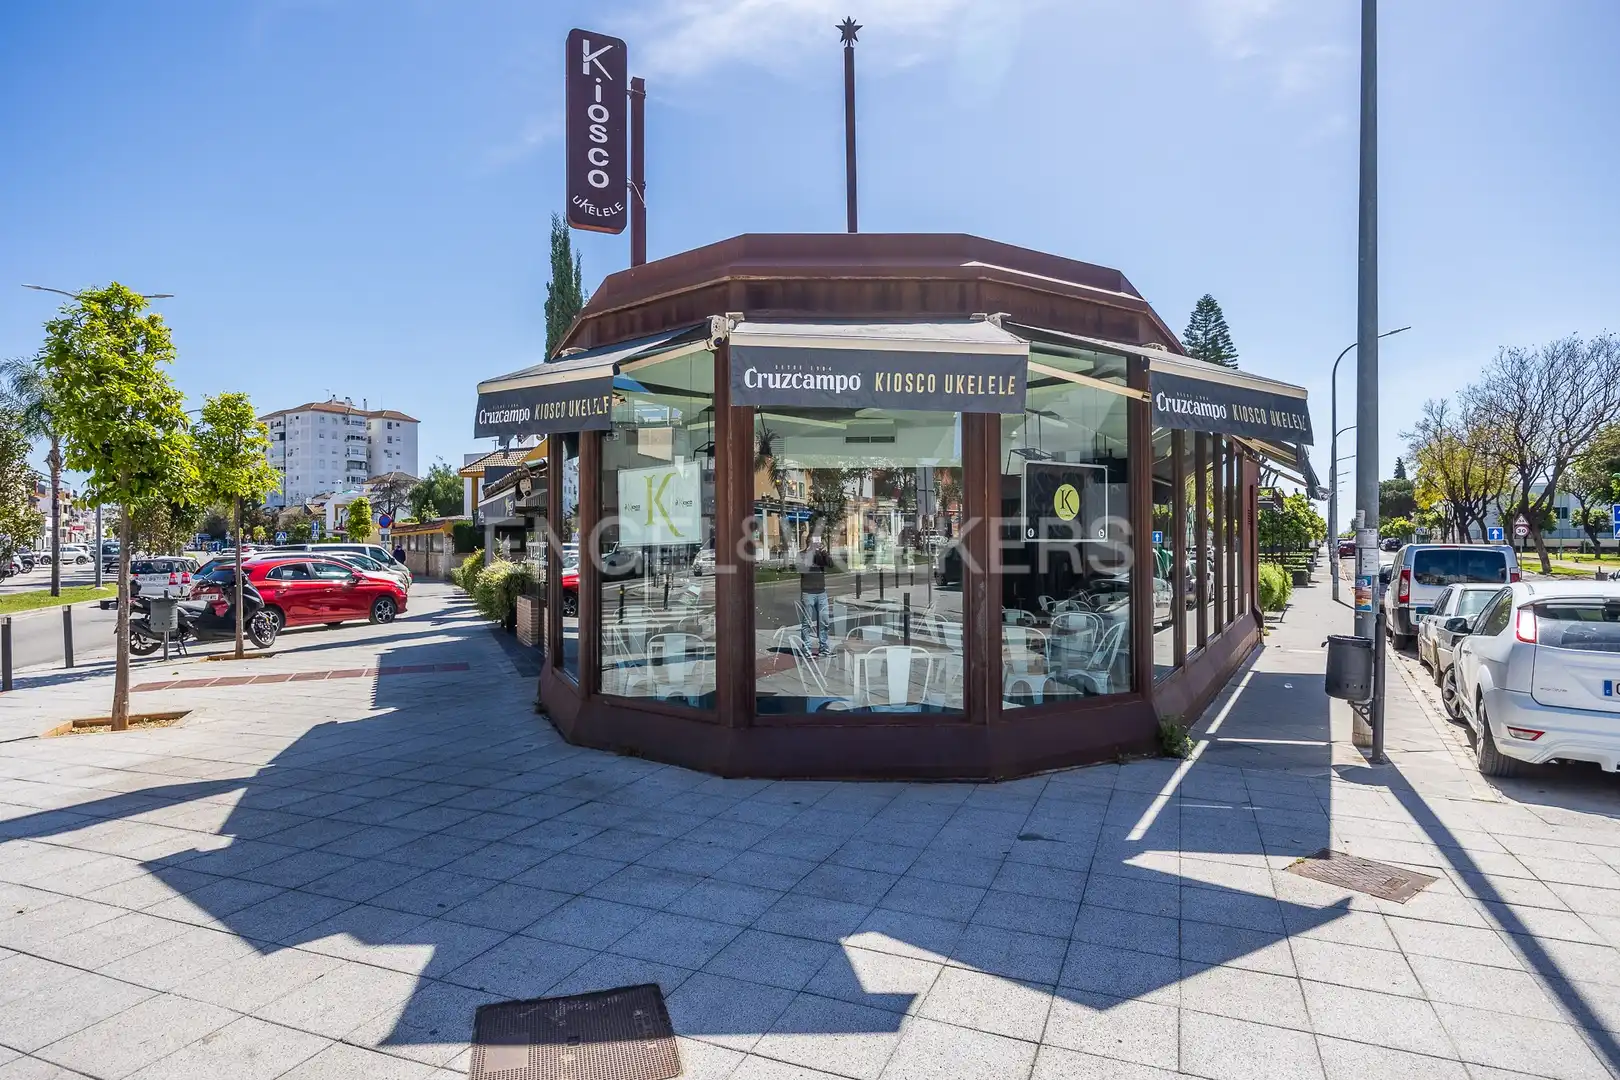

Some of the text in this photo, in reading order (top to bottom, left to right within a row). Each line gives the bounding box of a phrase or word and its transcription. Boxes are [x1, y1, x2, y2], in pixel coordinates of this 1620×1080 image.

[744, 366, 1016, 395] Cruzcampo KIOSCO UKELELE
[478, 407, 531, 425] Cruzcampo
[534, 401, 565, 421] KIOSCO
[1155, 391, 1227, 420] Cruzcampo
[1231, 404, 1267, 425] KIOSCO
[643, 472, 685, 537] K
[1060, 489, 1076, 514] K
